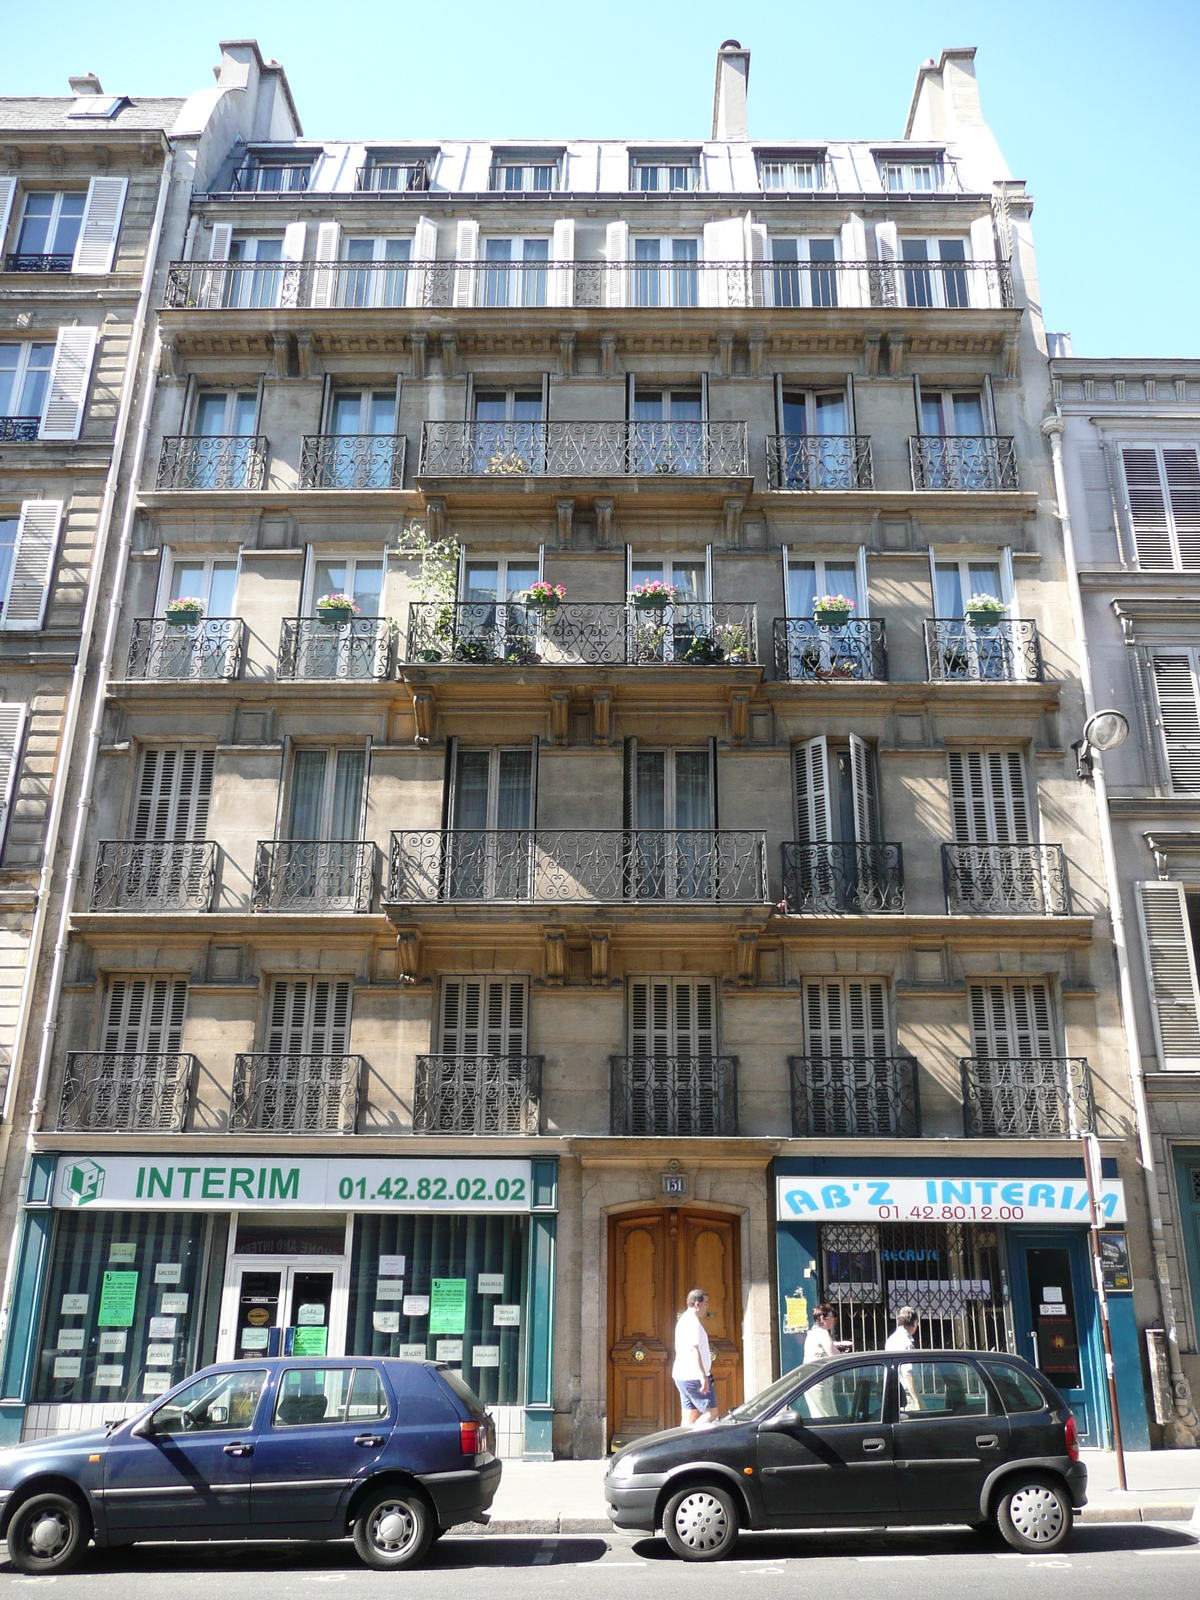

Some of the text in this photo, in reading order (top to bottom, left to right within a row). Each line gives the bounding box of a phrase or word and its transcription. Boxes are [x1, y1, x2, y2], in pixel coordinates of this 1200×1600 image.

[135, 1166, 526, 1201] INTERIM 01.42.82.02.02
[666, 1178, 683, 1192] 131
[784, 1179, 1119, 1218] AB'Z INTERIM
[878, 1205, 1024, 1220] 01.42.80.12.00
